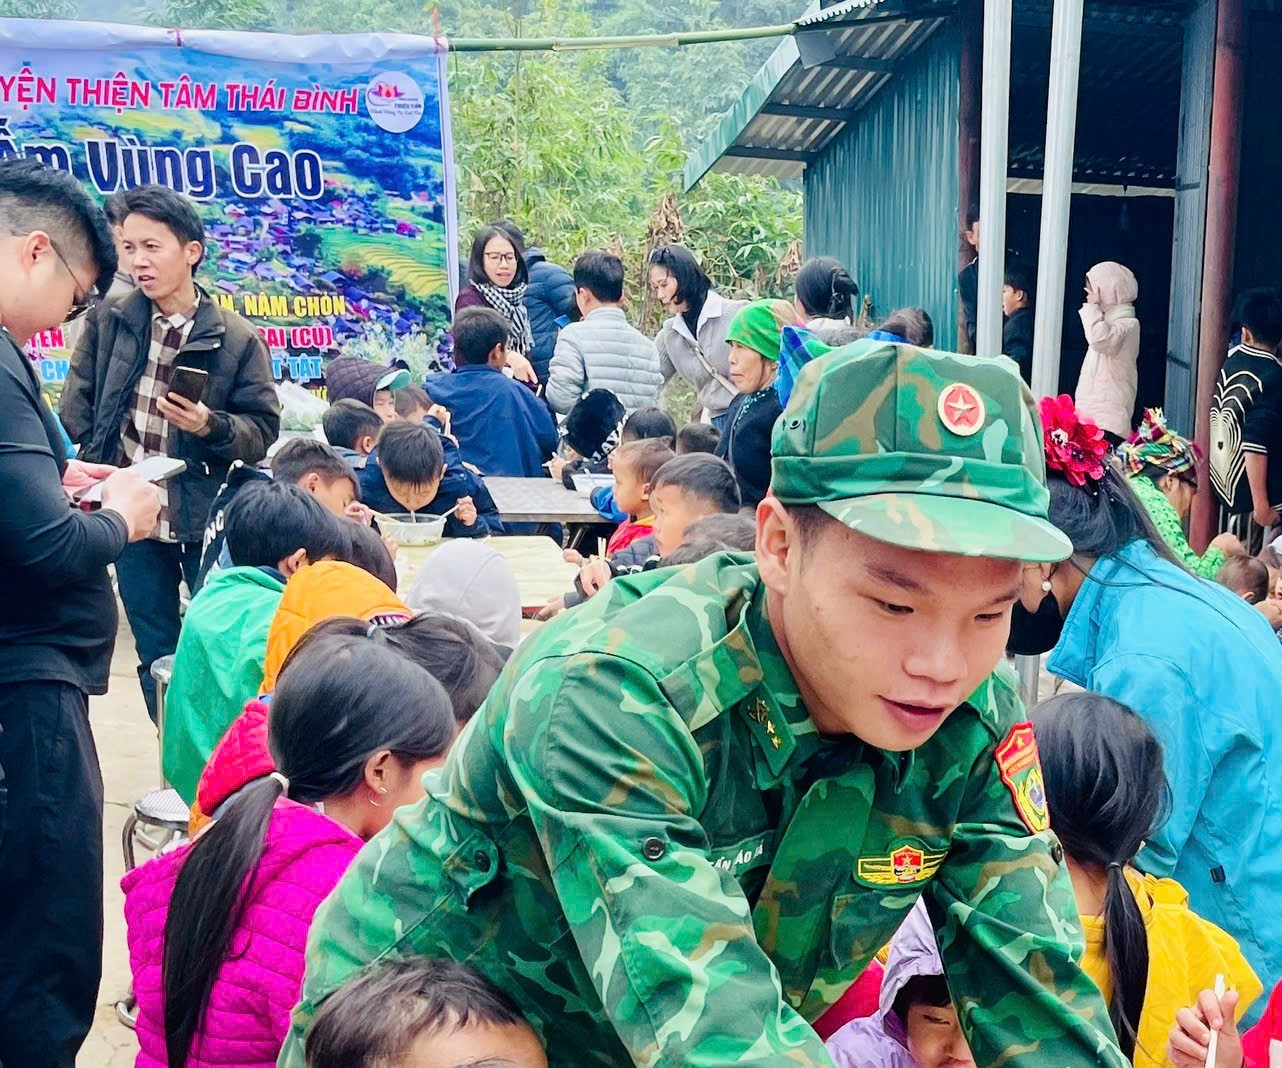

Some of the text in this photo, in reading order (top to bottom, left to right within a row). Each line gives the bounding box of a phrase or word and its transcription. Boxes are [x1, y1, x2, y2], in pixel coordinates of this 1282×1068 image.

[67, 72, 150, 114] THIỆN
[160, 75, 217, 108] TÂM
[226, 80, 285, 110] THÁI
[293, 85, 358, 113] BÌNH
[86, 136, 215, 198] Vùng
[232, 143, 323, 198] Cao
[244, 292, 289, 320] NẬM
[288, 355, 322, 382] TẬT
